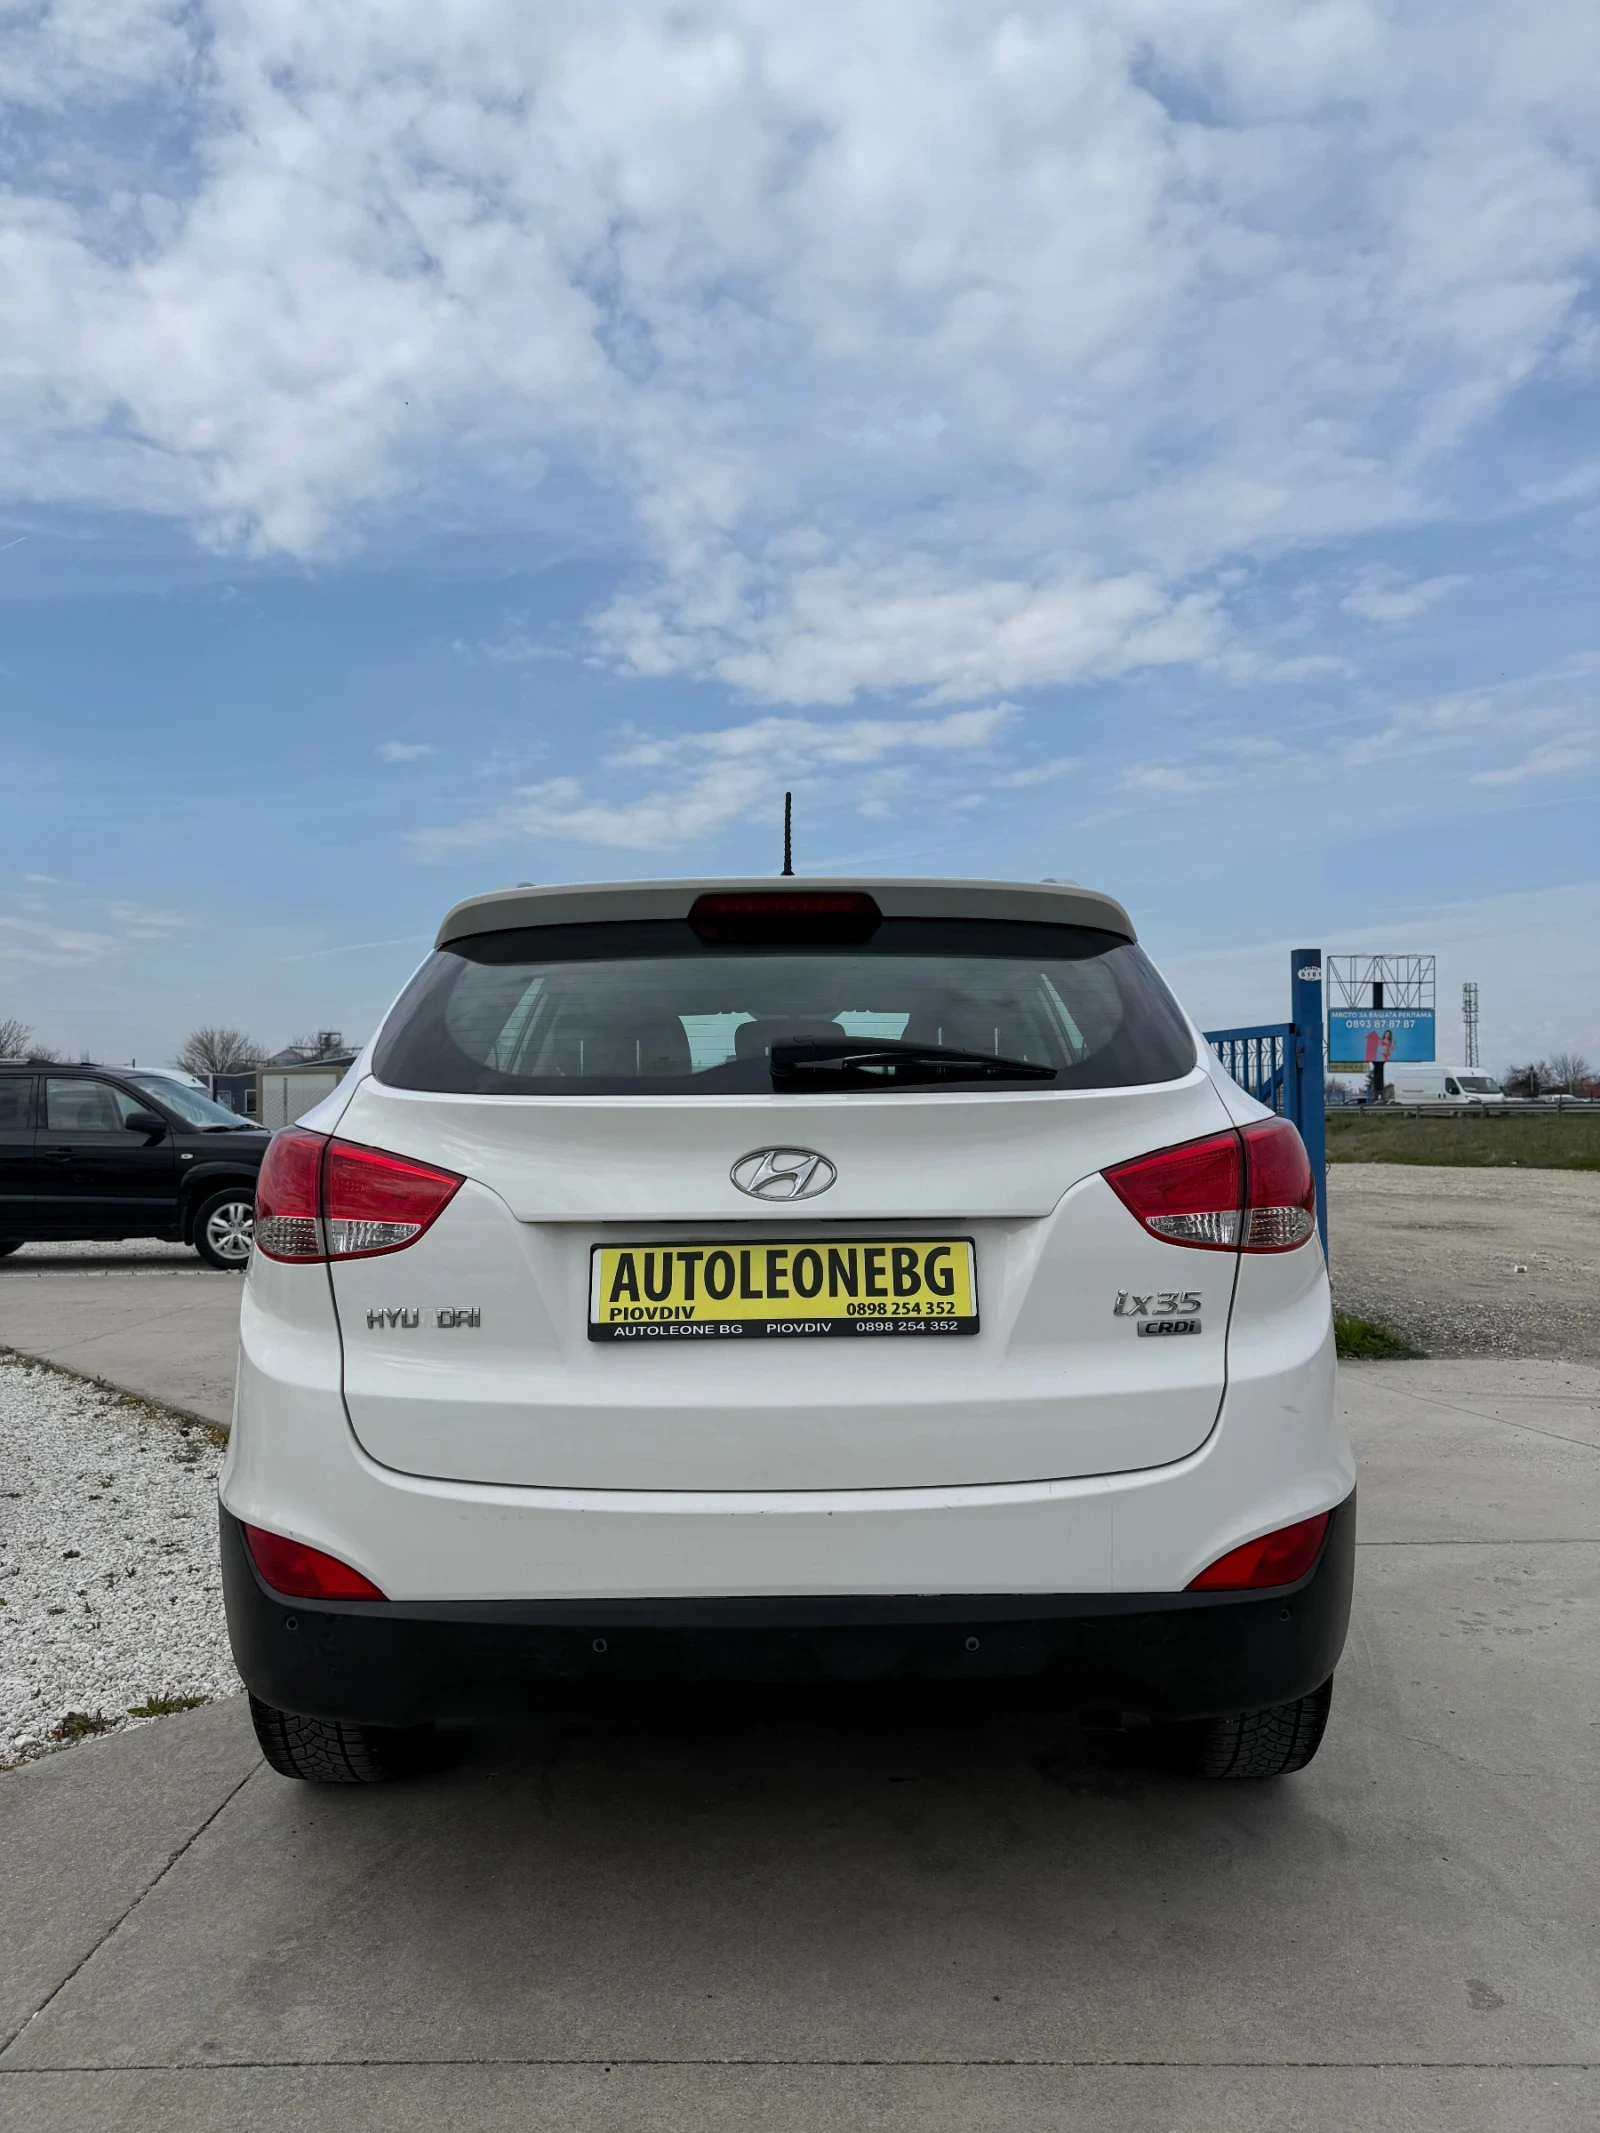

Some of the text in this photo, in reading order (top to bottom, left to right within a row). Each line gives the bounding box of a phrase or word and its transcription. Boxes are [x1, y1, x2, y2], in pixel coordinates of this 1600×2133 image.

[1345, 1020, 1415, 1028] 0893 87 87 87
[609, 1246, 955, 1303] AUTOLEONEBG
[846, 1301, 956, 1316] 0898 254 352
[1113, 1289, 1202, 1316] ix35
[366, 1306, 481, 1329] HYUDAI
[609, 1305, 695, 1321] PIOVDIV
[613, 1324, 743, 1336] AUTOLEONE BG
[766, 1323, 832, 1334] PIOVDIV
[856, 1321, 958, 1332] 0898 254 352
[1145, 1321, 1196, 1334] CRDi
